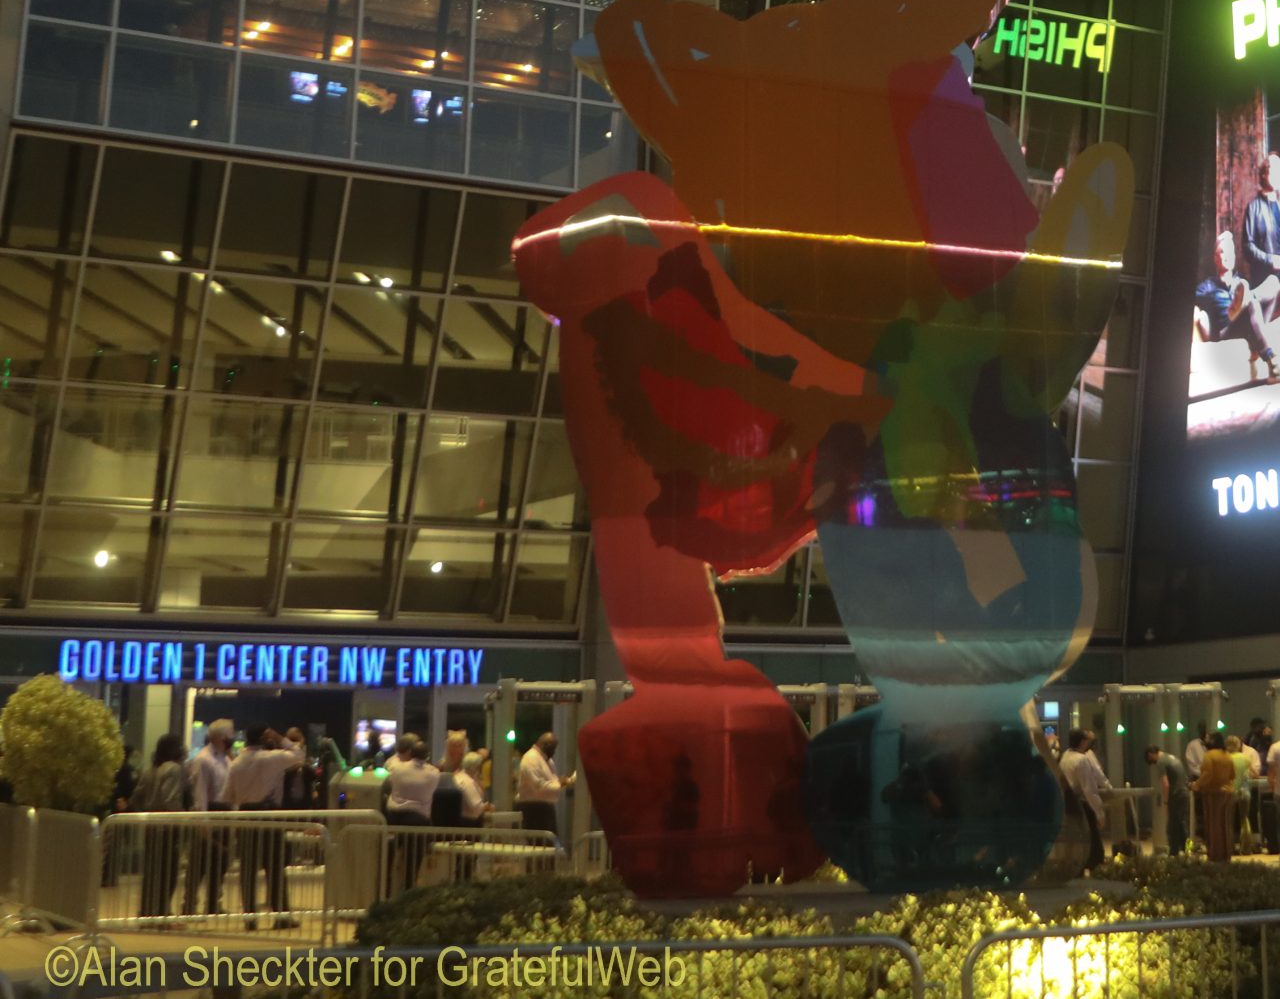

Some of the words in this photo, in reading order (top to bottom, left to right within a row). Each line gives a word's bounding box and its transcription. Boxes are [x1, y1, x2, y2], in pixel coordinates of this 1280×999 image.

[59, 639, 183, 682] GOLDEN
[195, 642, 206, 682] 1
[216, 643, 329, 684] CENTER
[339, 646, 387, 686] NW
[396, 648, 484, 687] ENTRY
